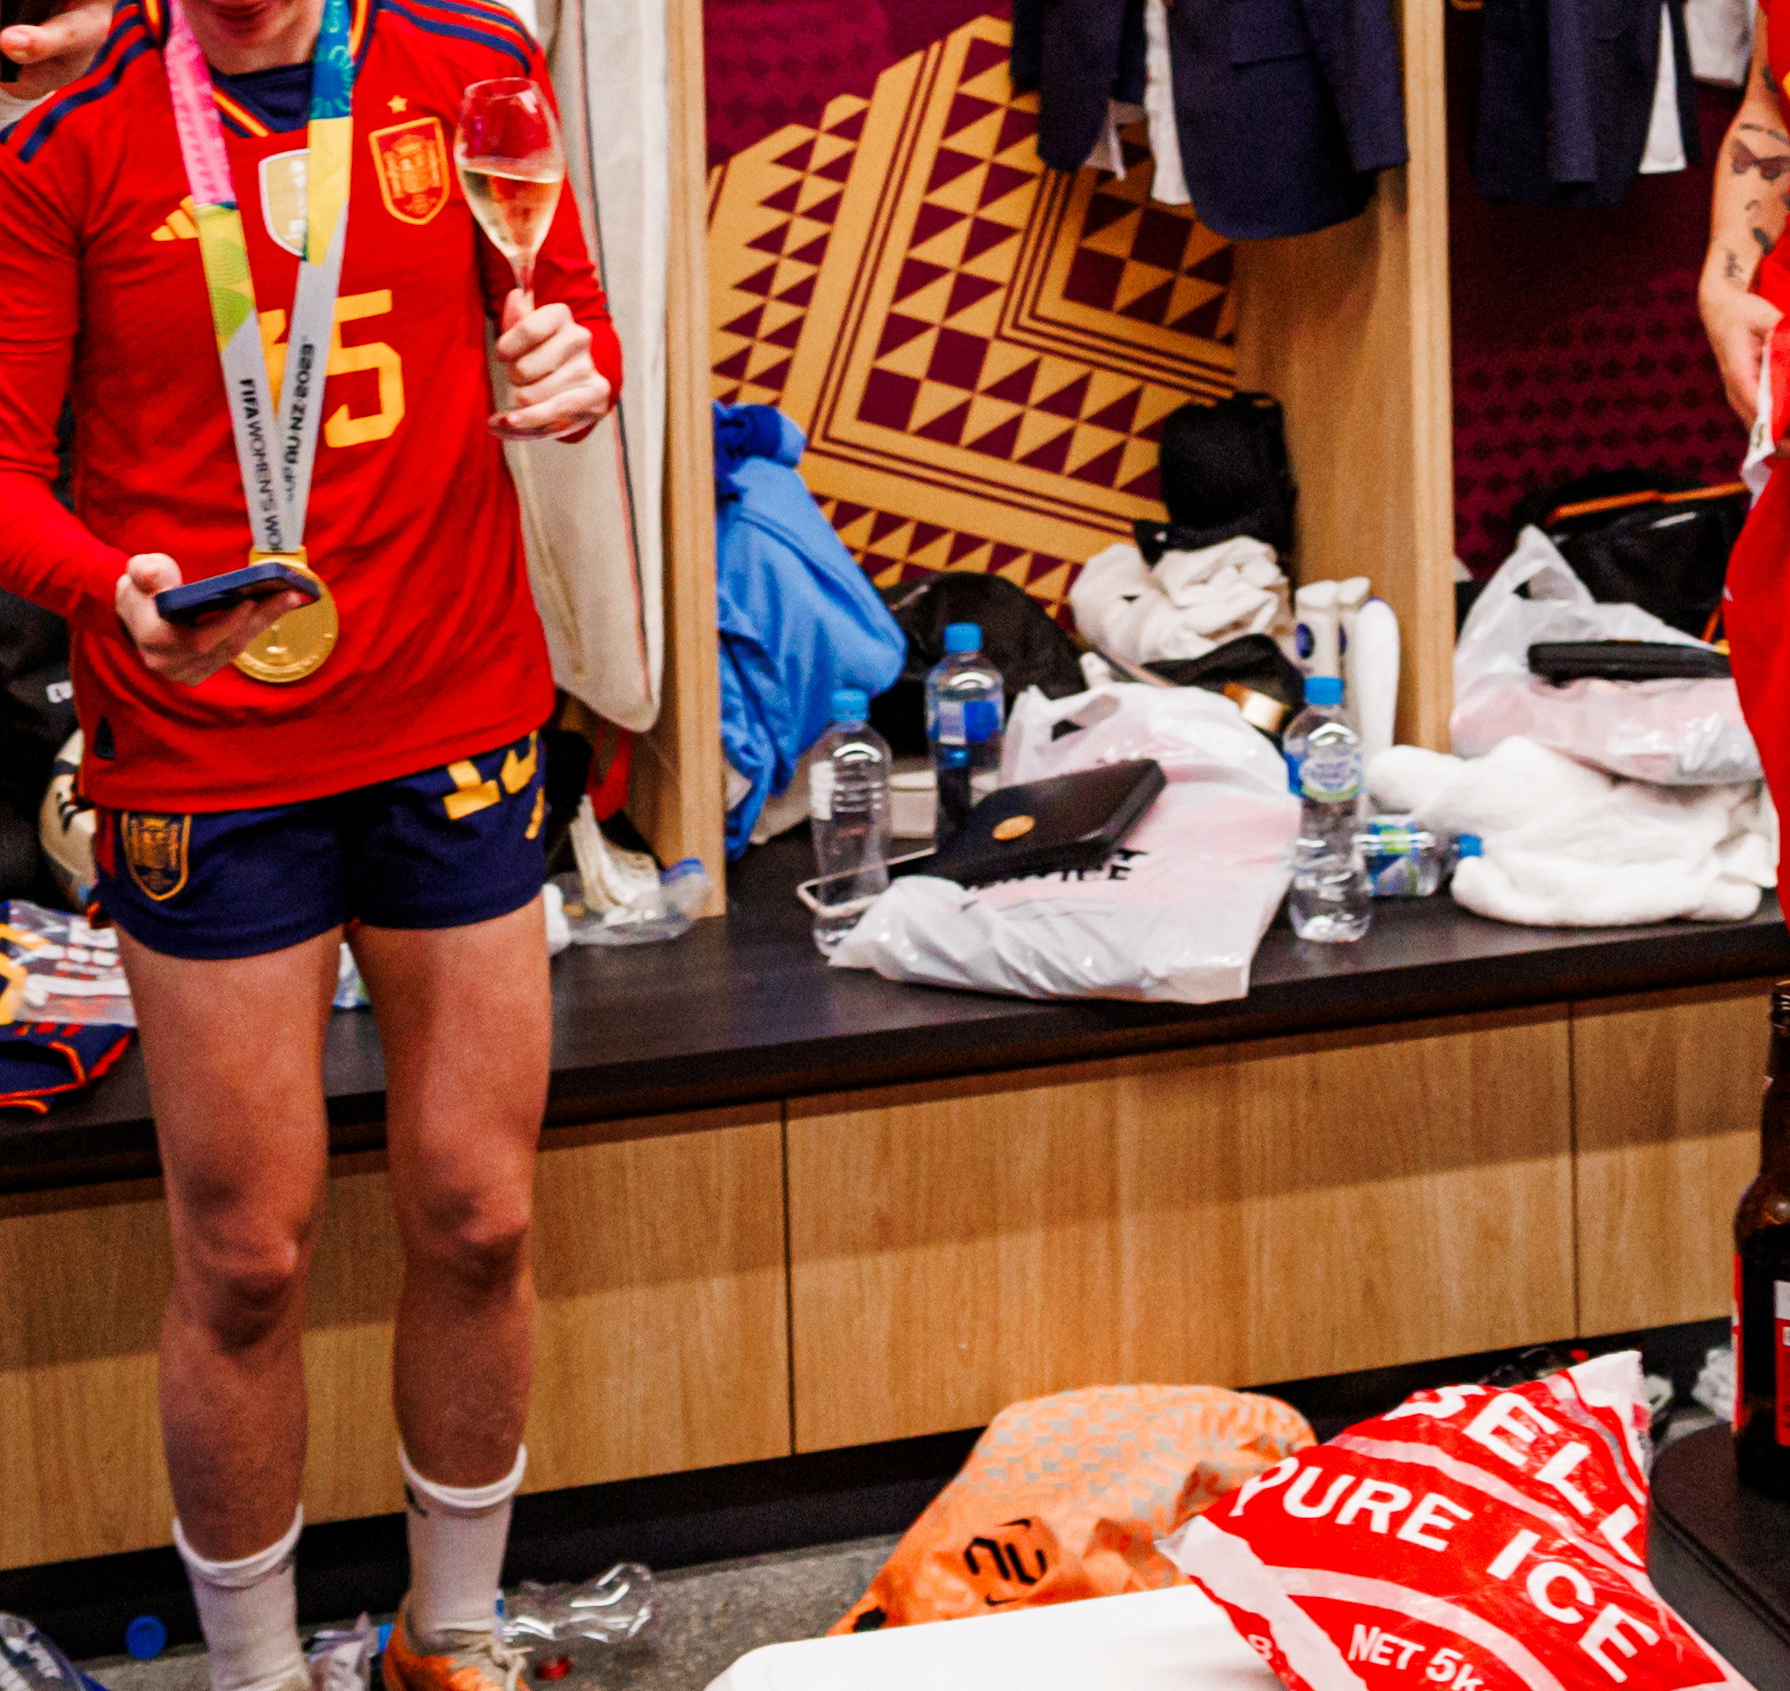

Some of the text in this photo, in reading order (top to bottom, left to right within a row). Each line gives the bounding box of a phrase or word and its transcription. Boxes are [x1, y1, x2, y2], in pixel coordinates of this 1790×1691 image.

[1228, 1456, 1474, 1552] PURE
[1347, 1623, 1426, 1671] NET
[1485, 1527, 1661, 1684] ICE
